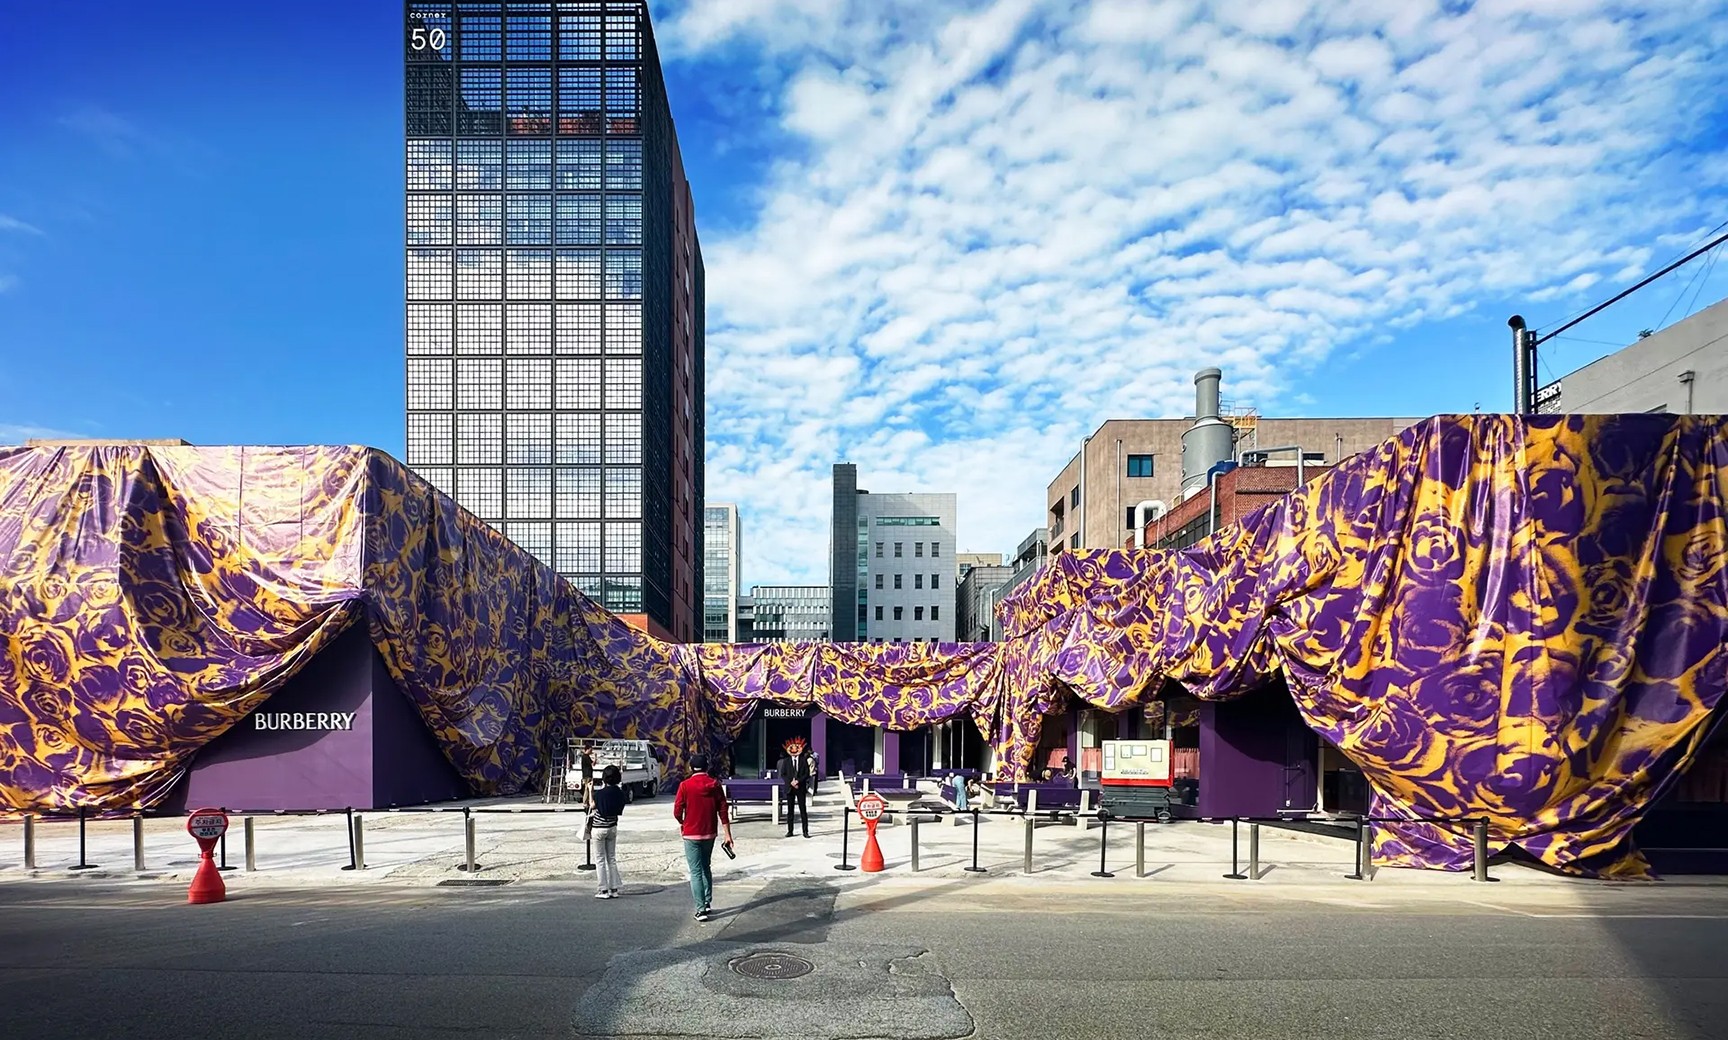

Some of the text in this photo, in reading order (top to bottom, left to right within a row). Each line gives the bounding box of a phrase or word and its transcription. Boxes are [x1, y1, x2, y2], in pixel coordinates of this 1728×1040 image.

[411, 28, 446, 50] 50
[254, 712, 356, 730] BURBERRY
[763, 708, 806, 717] BURBERRY
